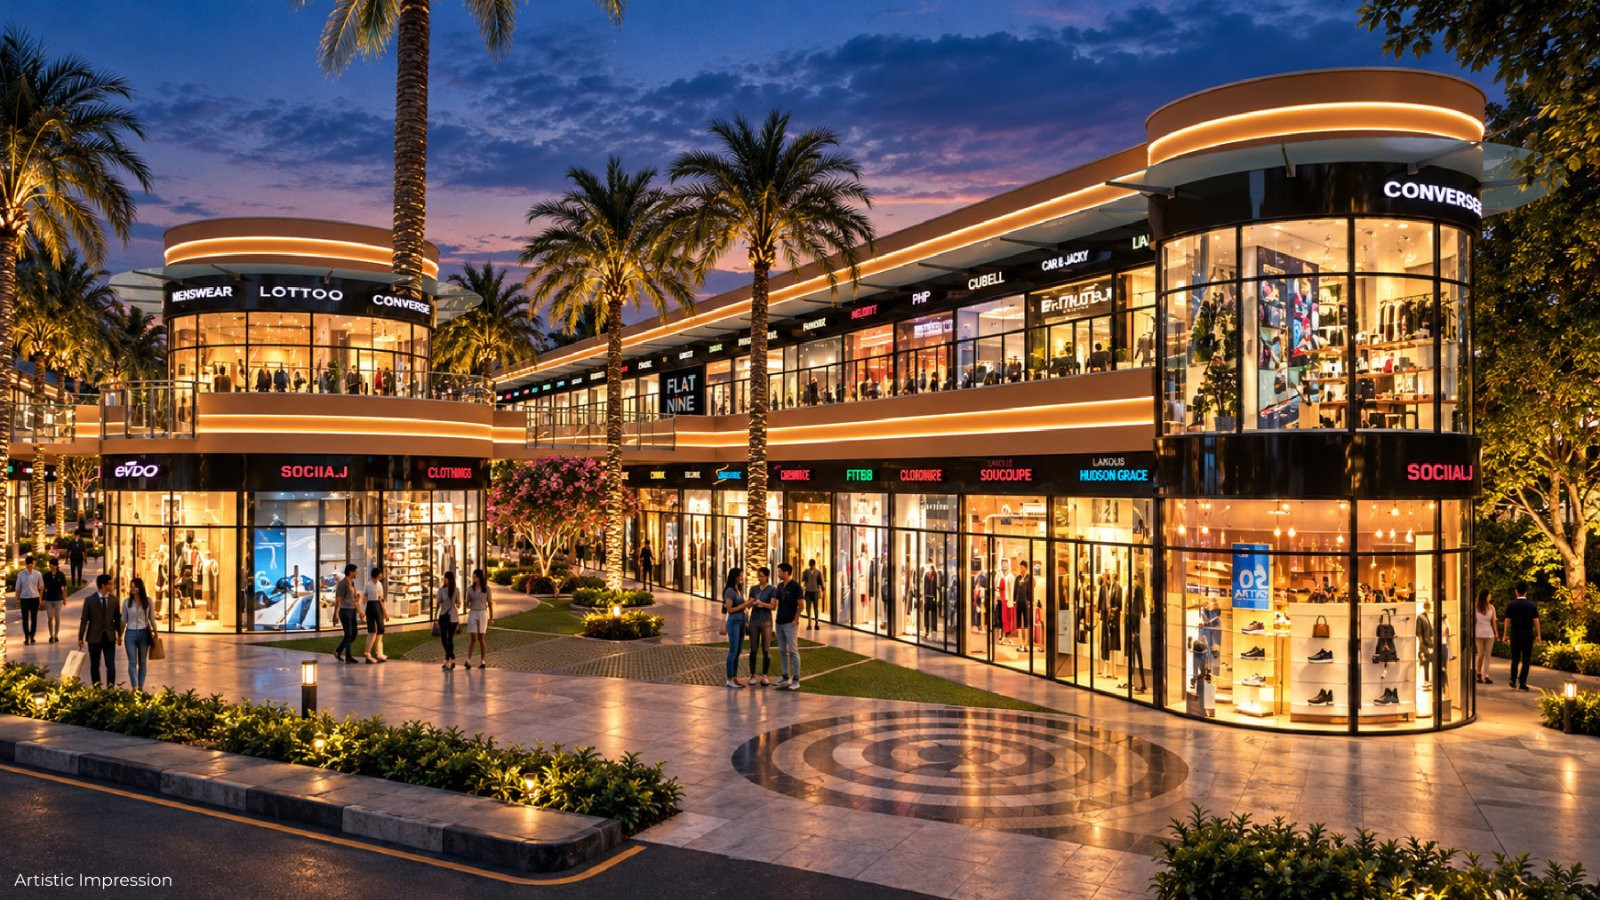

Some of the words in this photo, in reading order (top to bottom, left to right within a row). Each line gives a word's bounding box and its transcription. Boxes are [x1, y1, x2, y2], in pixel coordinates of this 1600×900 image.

[968, 272, 1004, 290] CUBELL
[172, 286, 232, 302] MENSWEAR
[260, 286, 343, 300] LOTTOO
[913, 291, 930, 305] PHP
[372, 294, 431, 315] CONVERSE
[668, 375, 695, 393] FLAT
[667, 395, 695, 413] NINE
[980, 468, 1033, 481] SOUCOUPE
[1079, 469, 1115, 481] HUDSON
[1118, 469, 1149, 481] GRACE
